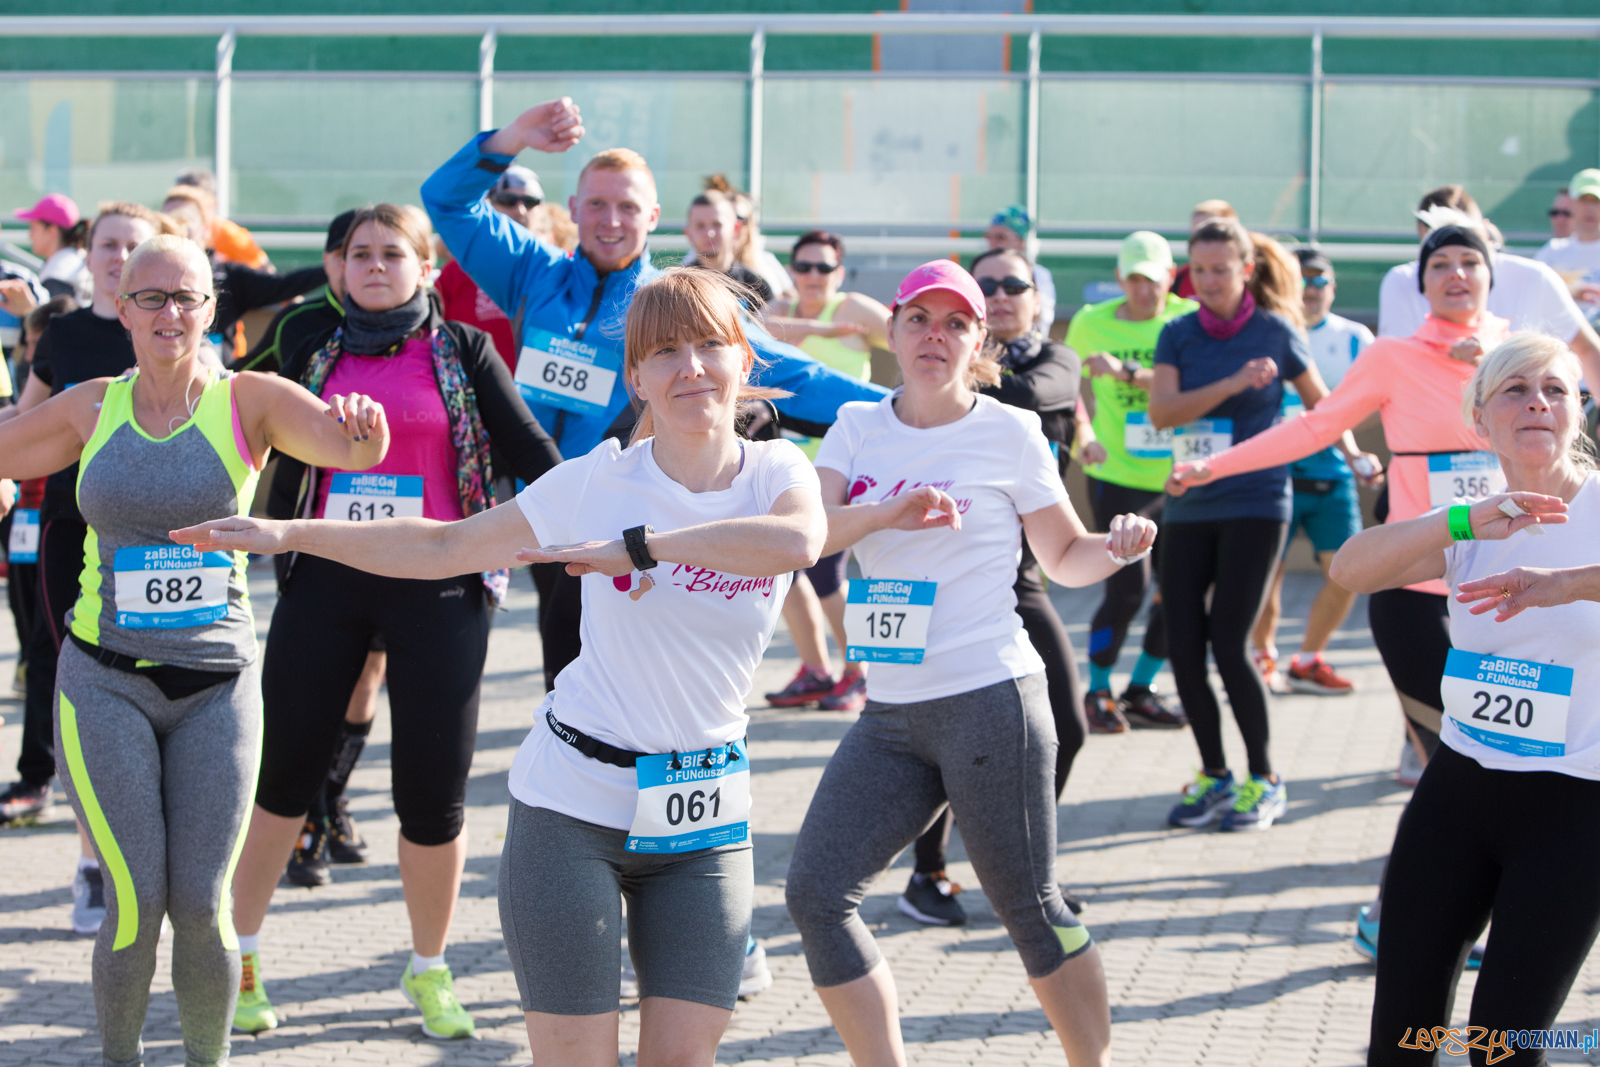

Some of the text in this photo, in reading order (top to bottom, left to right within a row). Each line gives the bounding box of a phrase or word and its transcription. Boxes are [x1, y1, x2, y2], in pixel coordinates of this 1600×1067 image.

[543, 361, 588, 391] 658
[351, 475, 397, 489] zaBIEGaj
[1454, 477, 1489, 498] 356
[145, 547, 203, 560] zaBIEGaj
[154, 560, 203, 570] FUNdusze
[146, 576, 202, 604] 682
[868, 581, 912, 596] zaBIEGaj
[873, 594, 909, 604] FUNdusze
[866, 612, 906, 638] 157
[1479, 660, 1541, 681] zaBIEGaj
[1486, 673, 1538, 689] FUNdusze
[1472, 691, 1533, 728] 220
[666, 787, 720, 826] 061
